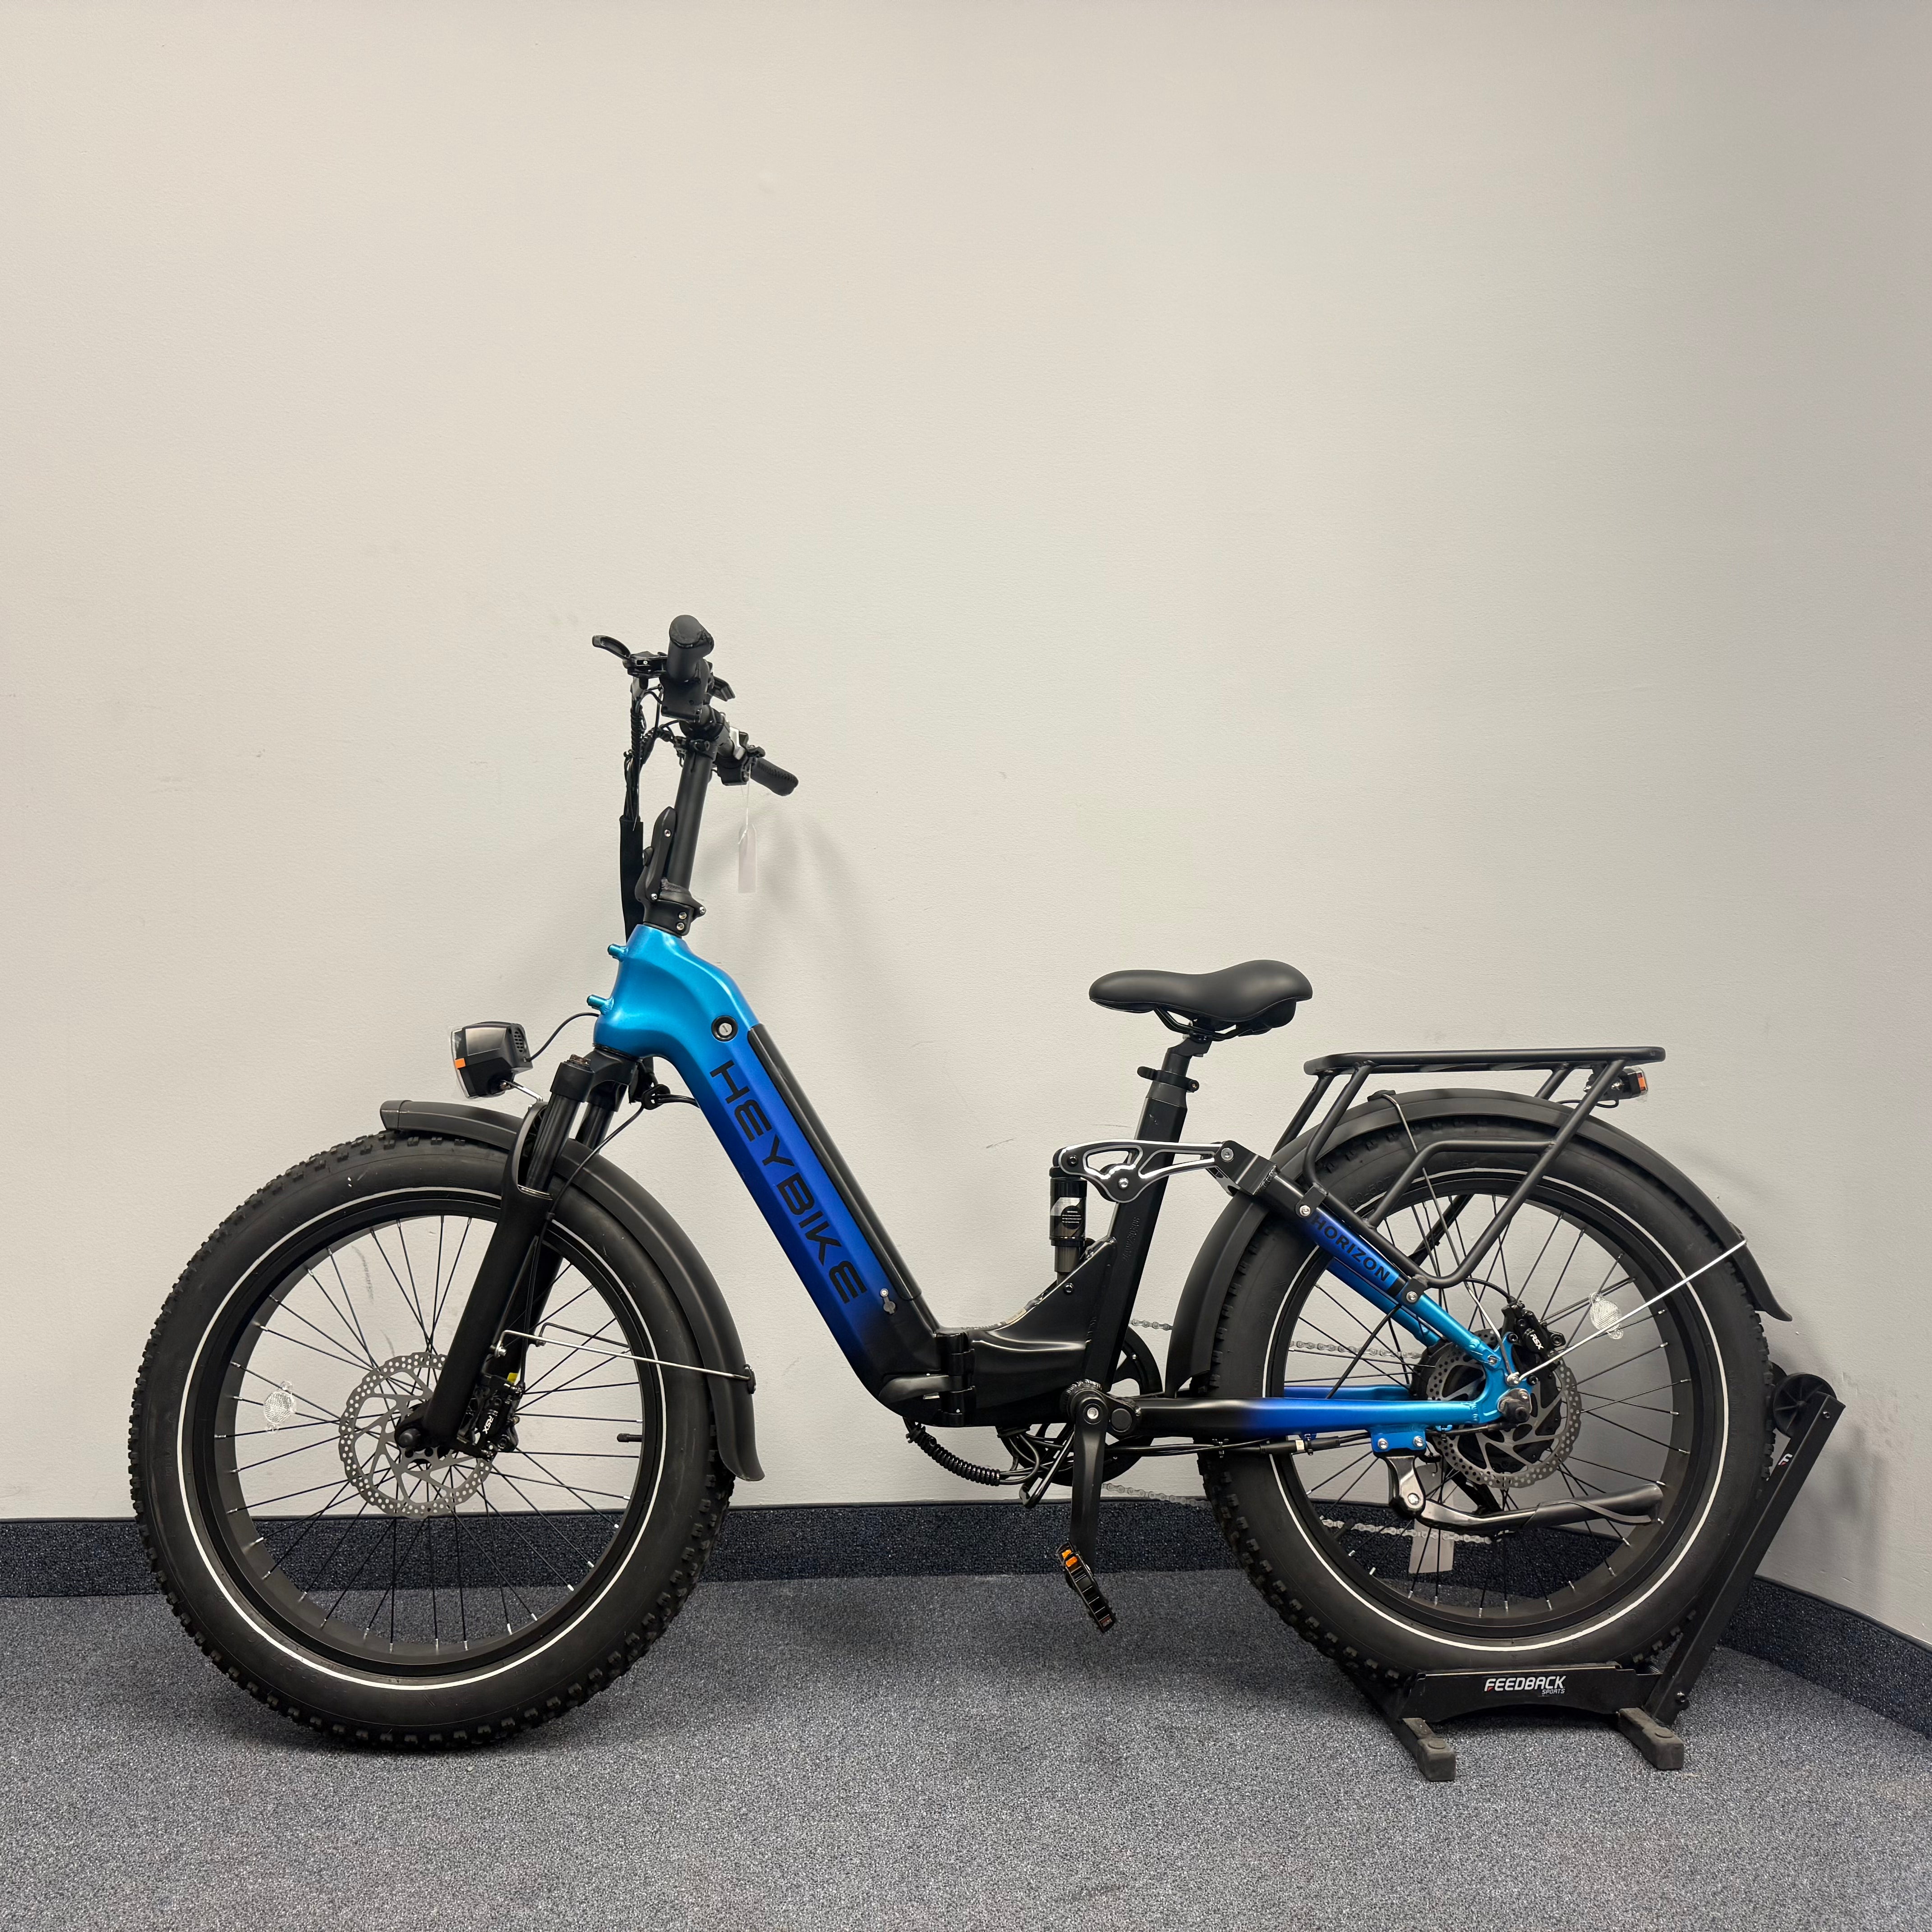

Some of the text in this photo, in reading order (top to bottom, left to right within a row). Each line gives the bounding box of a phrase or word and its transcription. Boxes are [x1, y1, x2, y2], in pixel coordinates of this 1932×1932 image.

[710, 1060, 868, 1304] HEYBIKE
[1310, 1214, 1390, 1281] HORIZON
[1530, 1334, 1544, 1350] RSX
[482, 1415, 494, 1434] RSX
[1484, 1676, 1566, 1692] FEEDBACK
